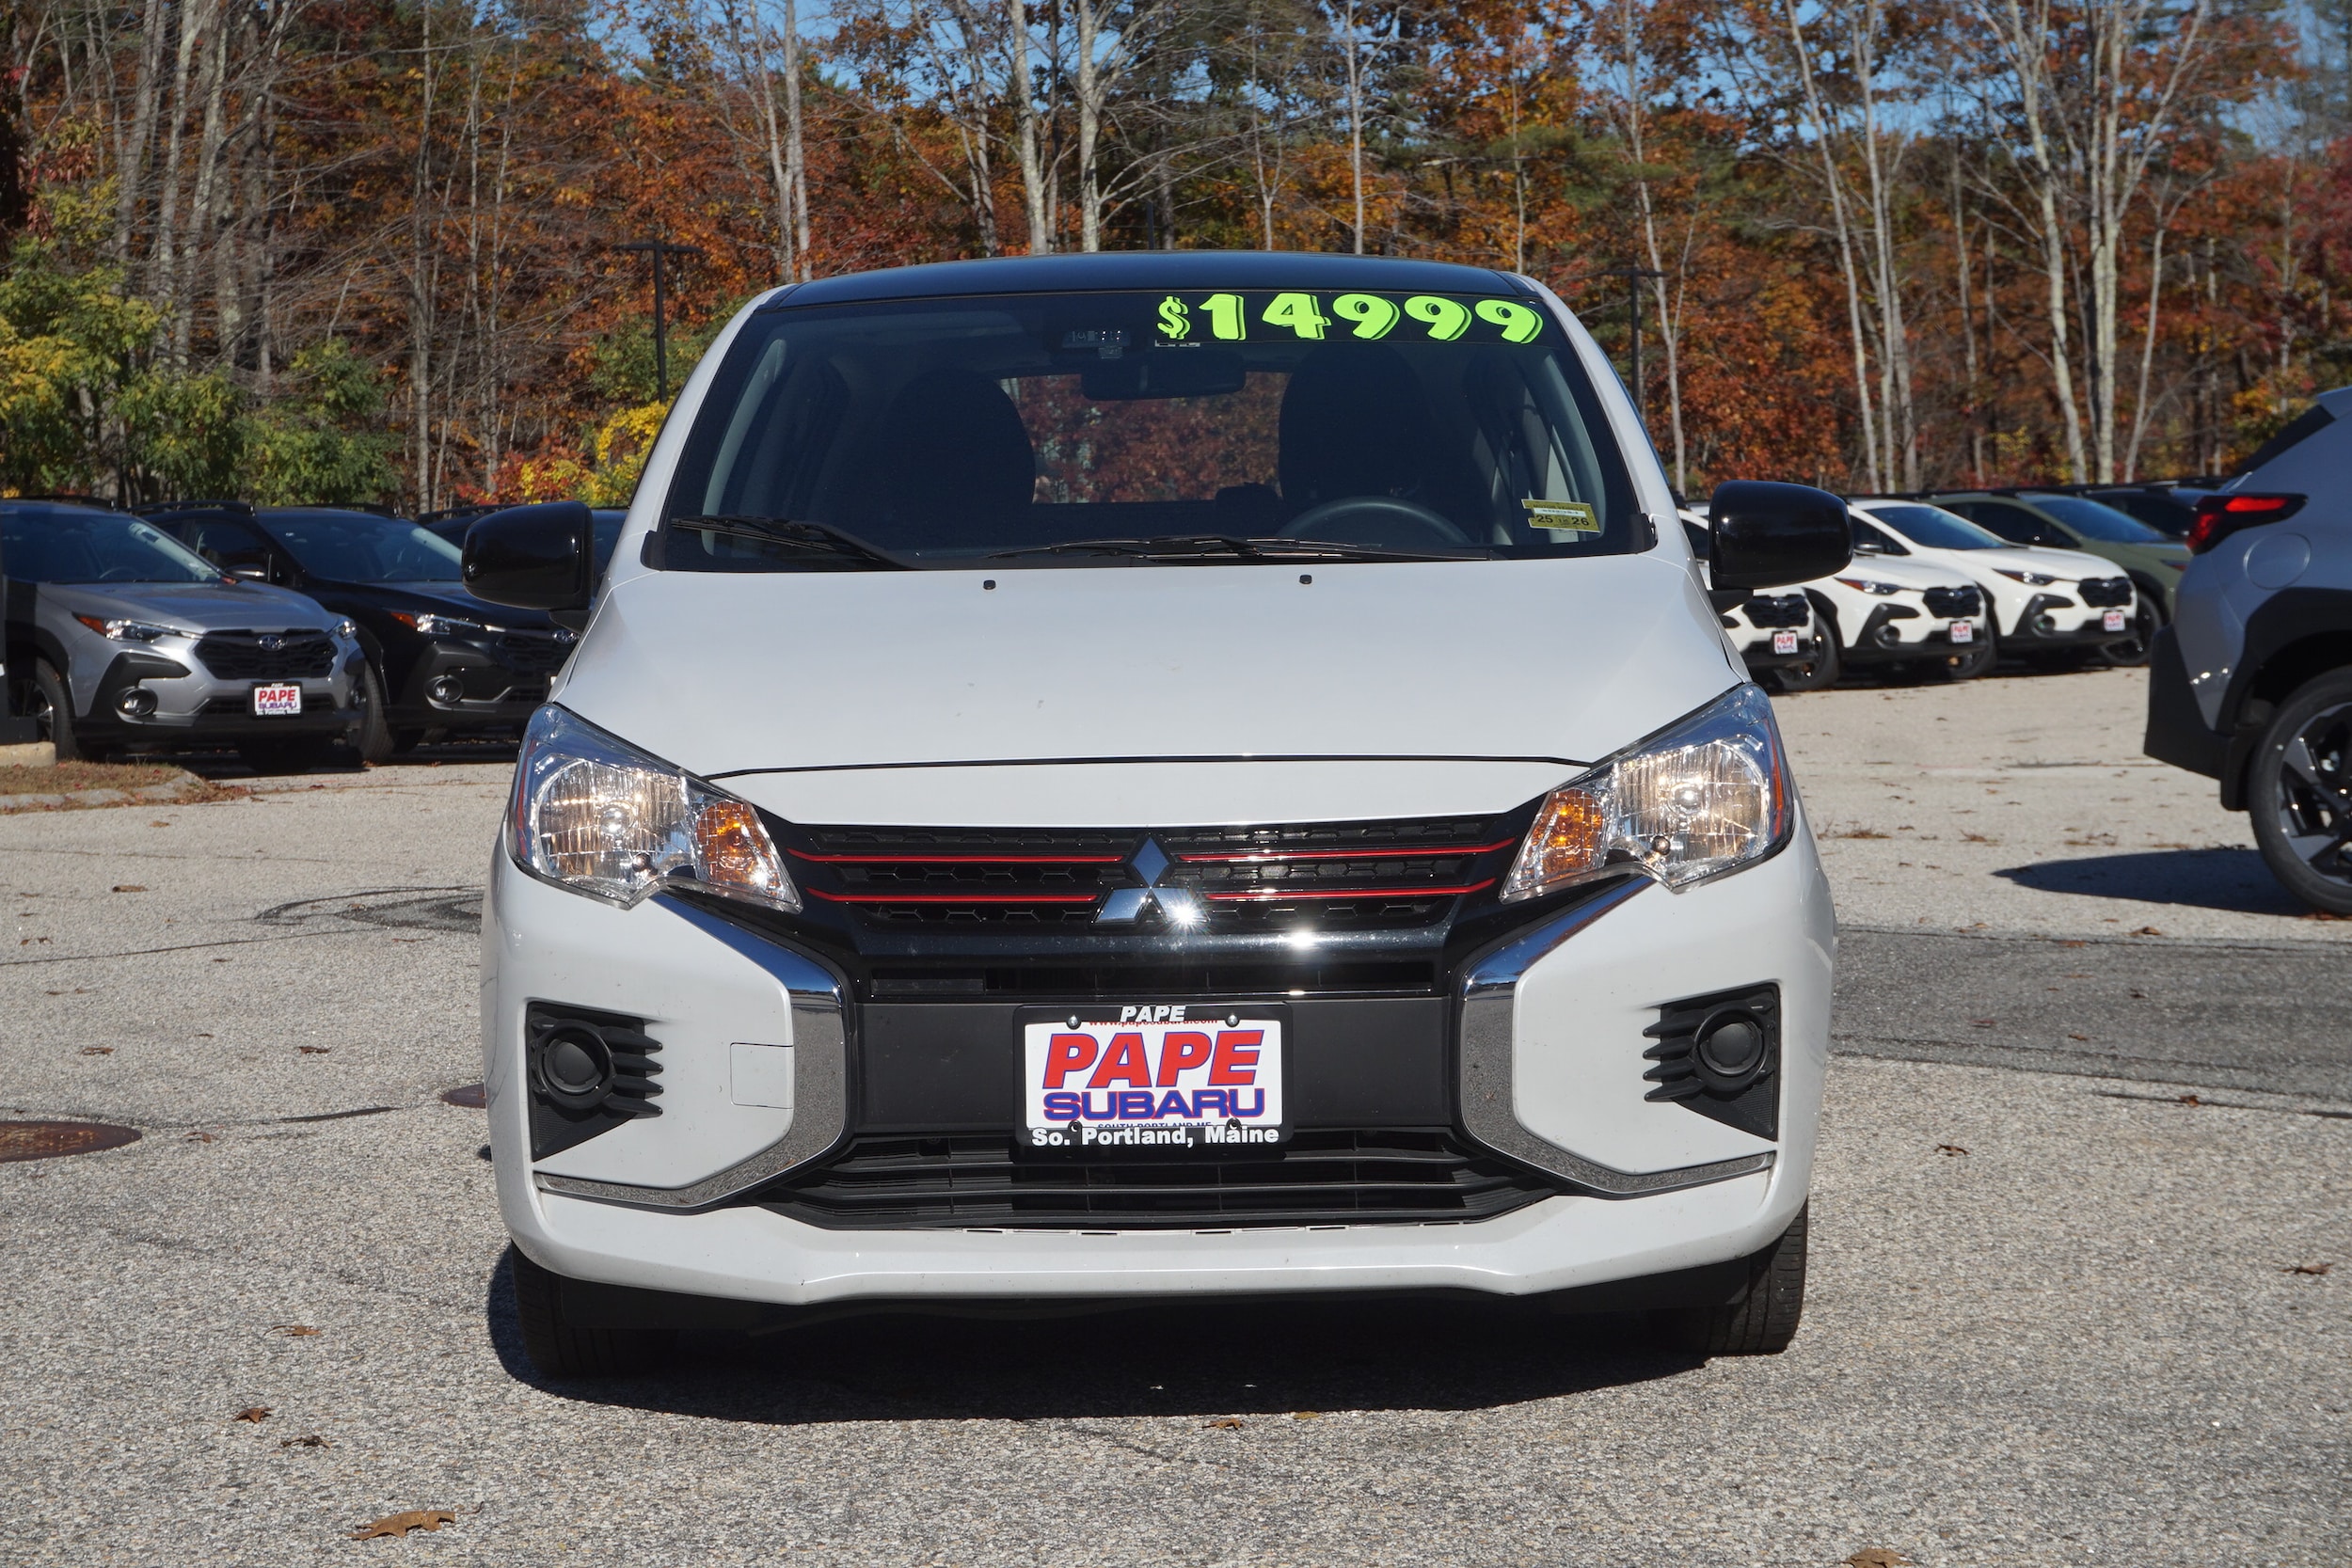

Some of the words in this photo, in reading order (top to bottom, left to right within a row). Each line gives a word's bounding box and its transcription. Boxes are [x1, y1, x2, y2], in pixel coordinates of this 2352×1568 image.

[1156, 293, 1544, 344] $14999
[1536, 515, 1553, 523] 25
[1571, 517, 1589, 526] 26
[259, 689, 296, 702] PAPE
[1120, 1005, 1186, 1022] PAPE
[1042, 1029, 1264, 1089] PAPE
[1043, 1088, 1264, 1120] SUBARU
[1032, 1127, 1071, 1146] So.
[1082, 1126, 1194, 1148] Portland,
[1204, 1125, 1279, 1144] Maine
